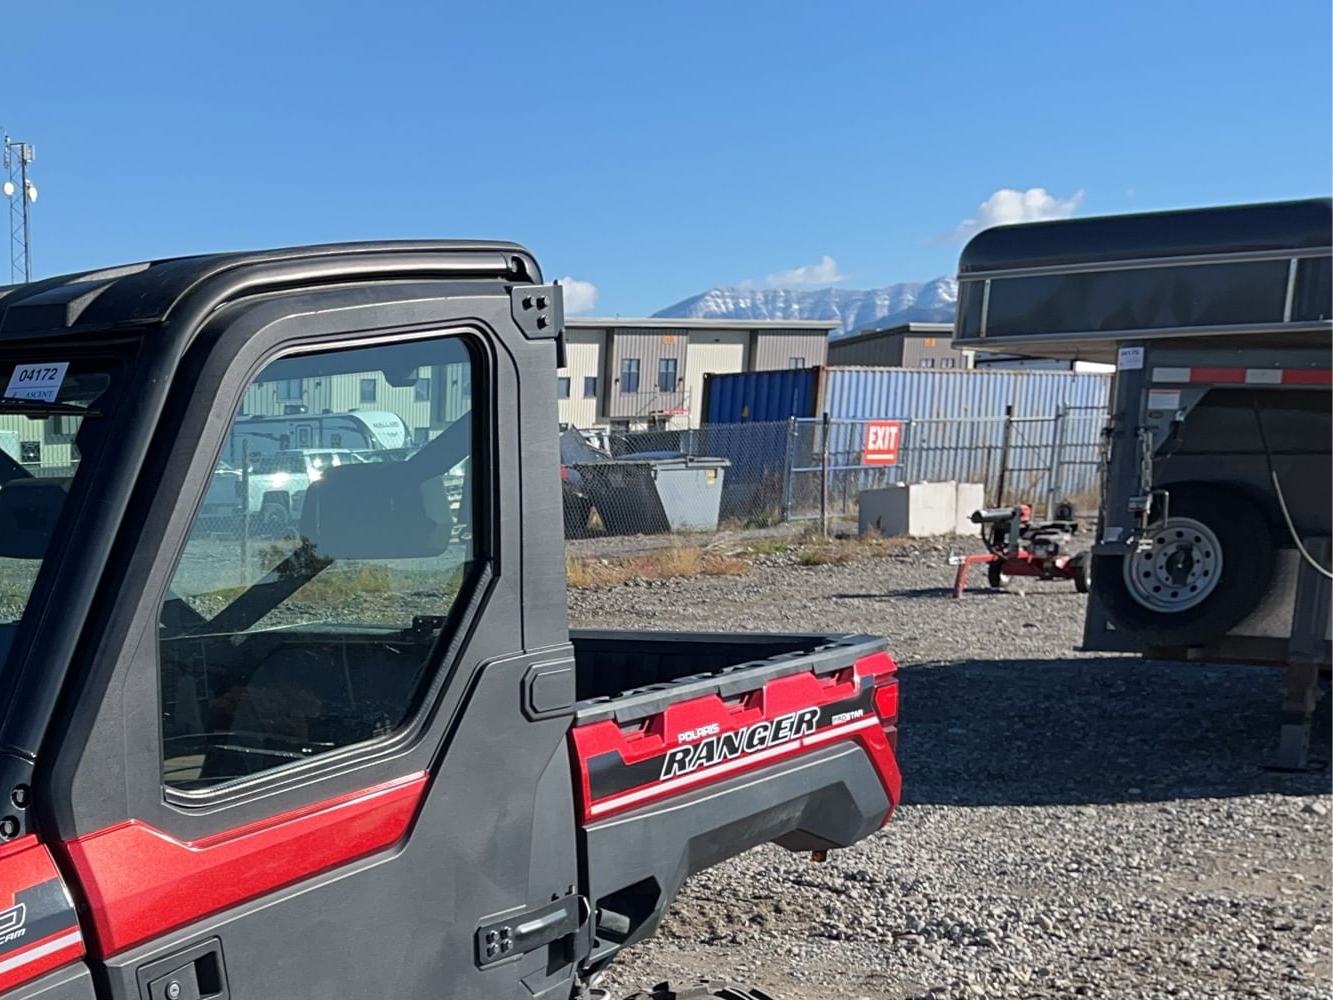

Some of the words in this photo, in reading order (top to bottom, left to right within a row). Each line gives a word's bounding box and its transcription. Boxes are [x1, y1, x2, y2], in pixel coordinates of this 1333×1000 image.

[19, 368, 58, 382] 04172
[868, 426, 898, 450] EXIT
[660, 706, 821, 781] RANGER
[678, 723, 720, 744] POLARIS
